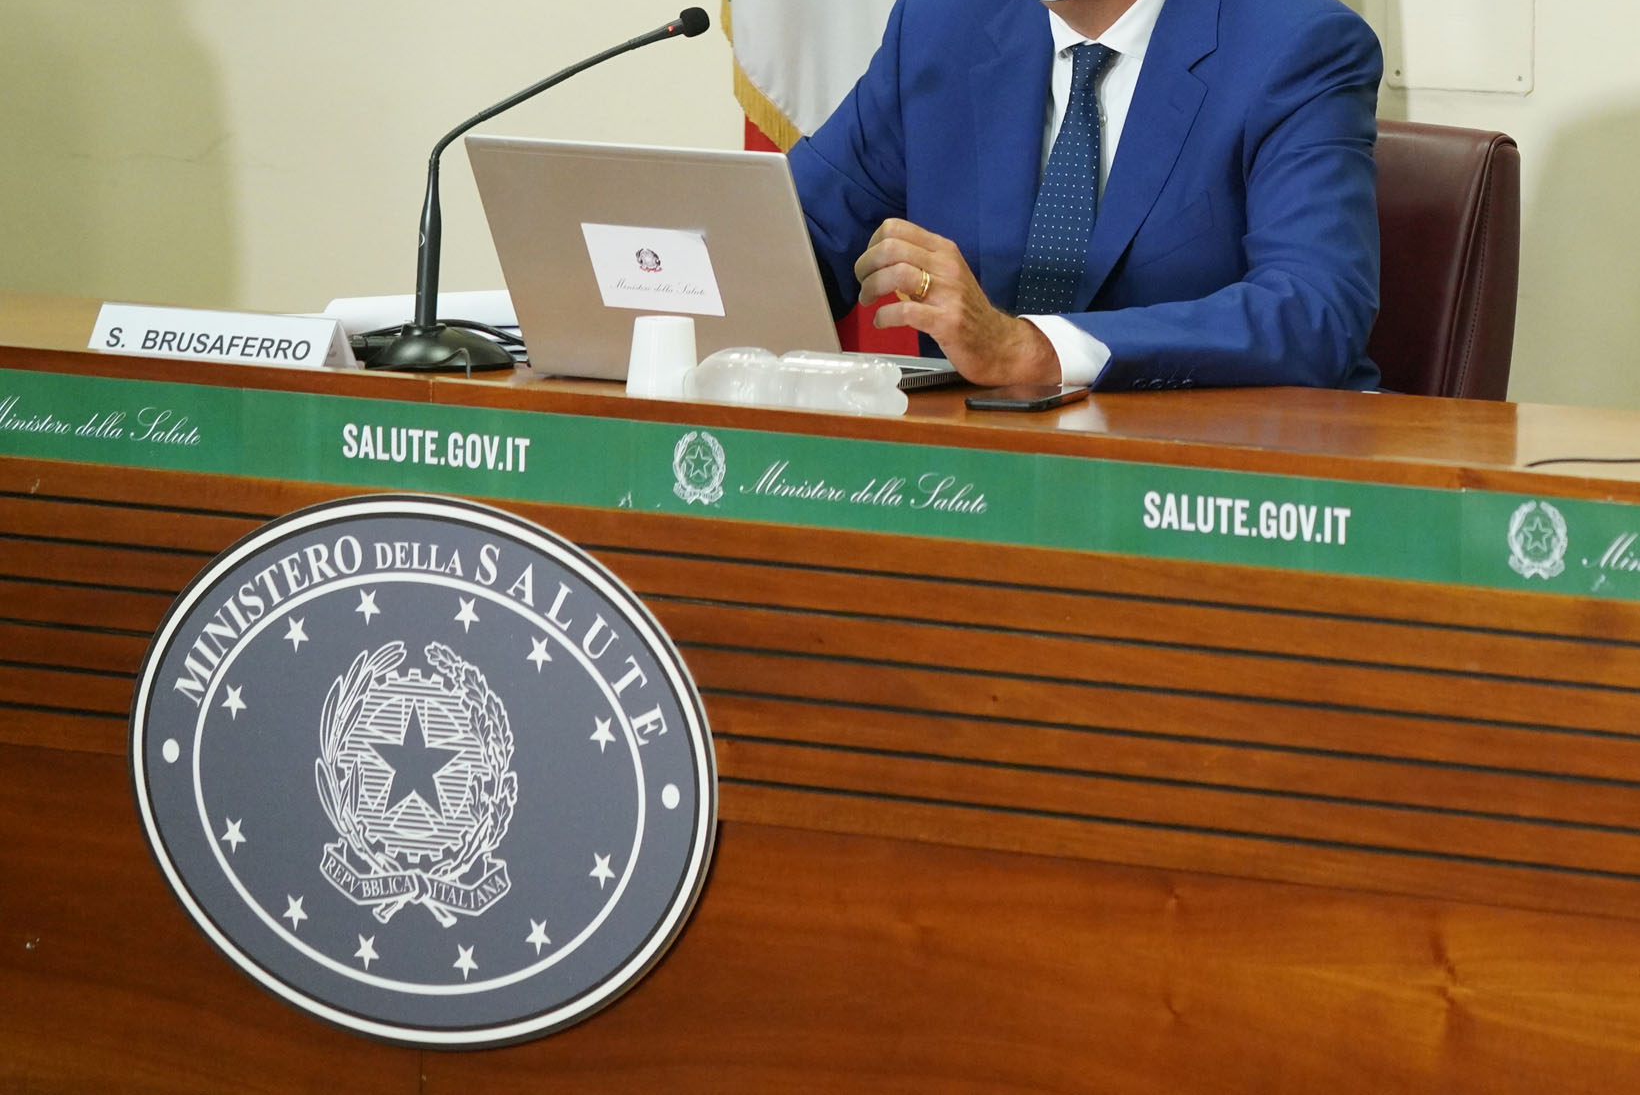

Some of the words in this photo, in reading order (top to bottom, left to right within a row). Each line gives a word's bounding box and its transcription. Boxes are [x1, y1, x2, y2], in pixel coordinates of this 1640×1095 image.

[106, 327, 125, 348] S.
[141, 330, 310, 360] BRUSAFERRO
[74, 411, 127, 440] della
[129, 405, 201, 447] Salute
[343, 423, 530, 472] SALUTE.GOV.IT
[739, 459, 847, 503] Ministero
[849, 477, 907, 507] della
[909, 471, 988, 516] Salute
[1144, 491, 1351, 544] SALUTE.GOV.IT
[174, 535, 364, 707] MINISTERO
[375, 541, 464, 576] DELLA
[474, 543, 669, 747] SALUTE
[323, 856, 413, 899] REPVBBLICA
[431, 873, 508, 910] ITALIANA
